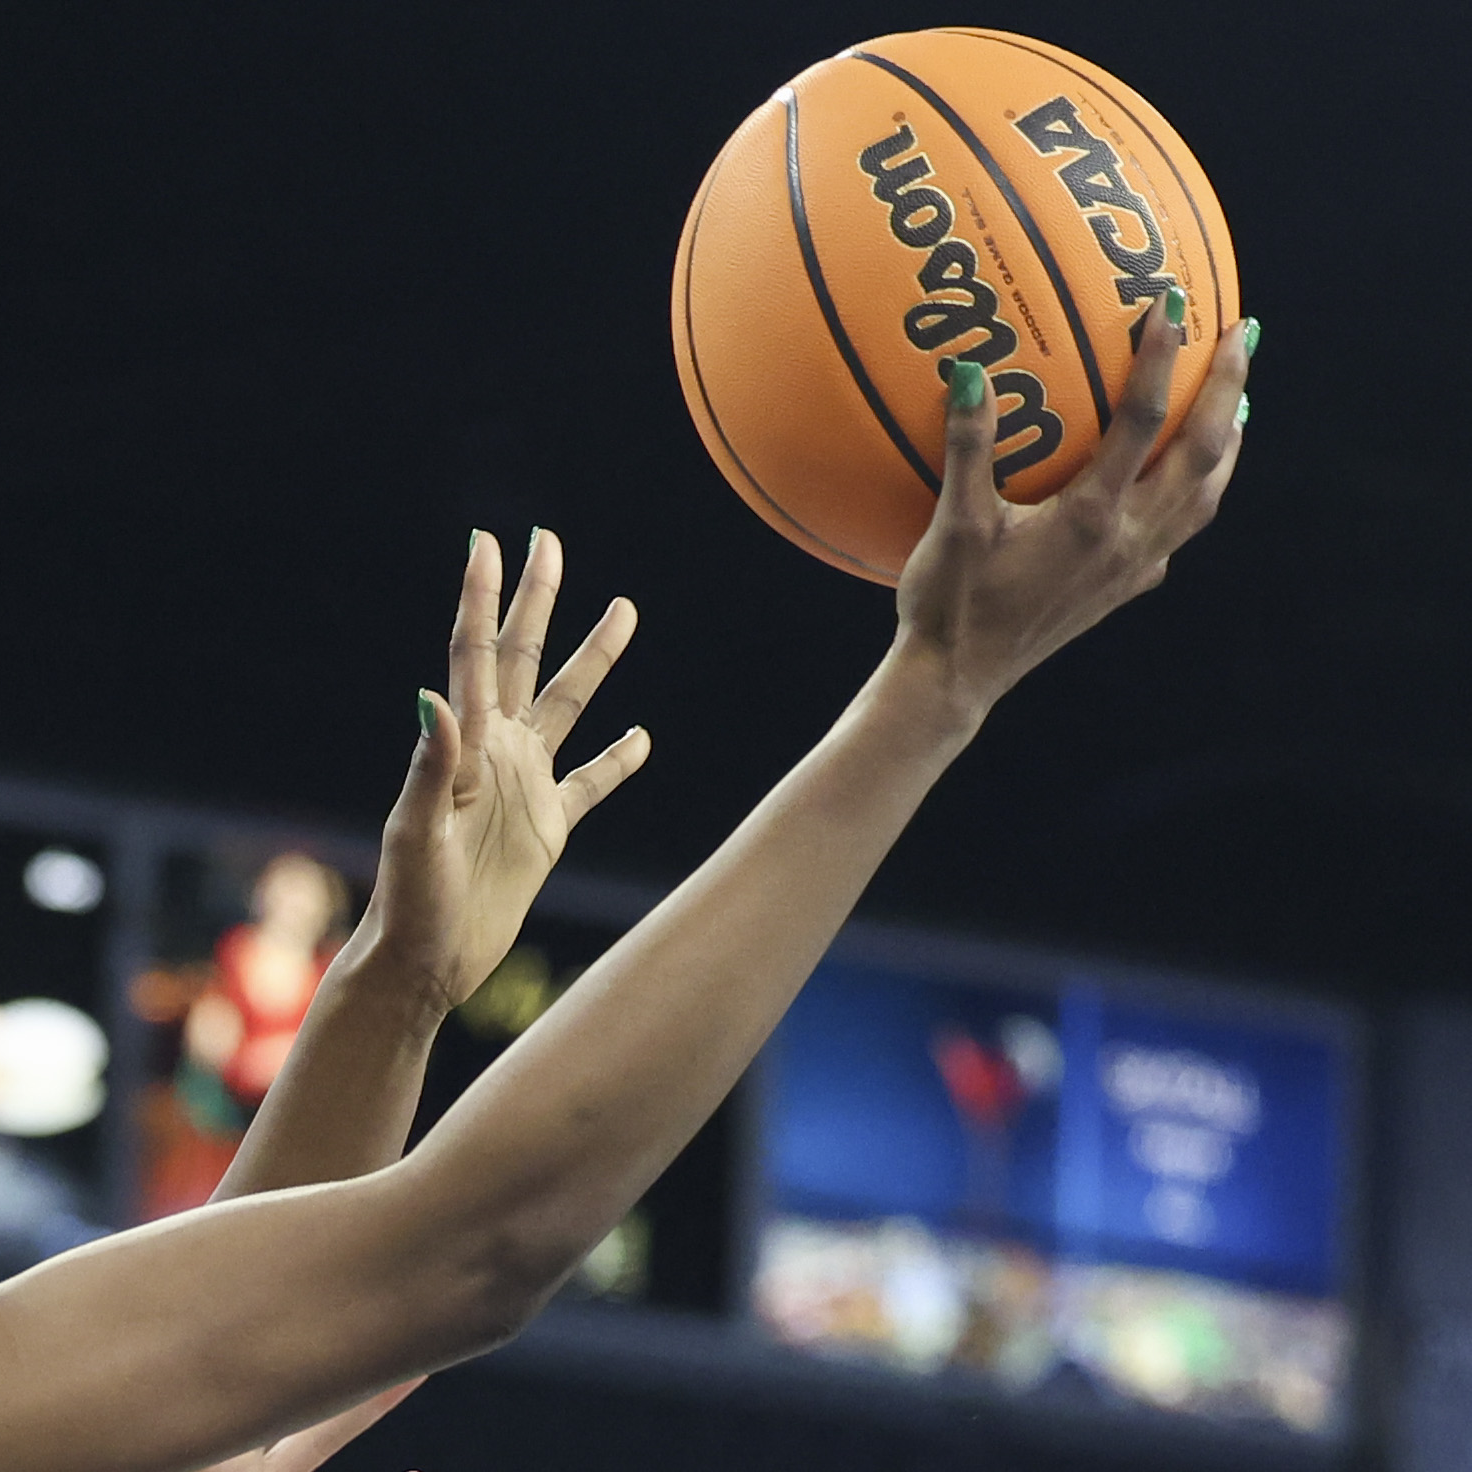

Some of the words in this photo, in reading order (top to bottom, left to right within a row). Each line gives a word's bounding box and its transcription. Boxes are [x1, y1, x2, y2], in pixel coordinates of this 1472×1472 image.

[961, 187, 987, 231] BALL
[983, 235, 1014, 286] GAME
[857, 122, 1065, 491] Wilson
[1011, 288, 1051, 357] INDOOR
